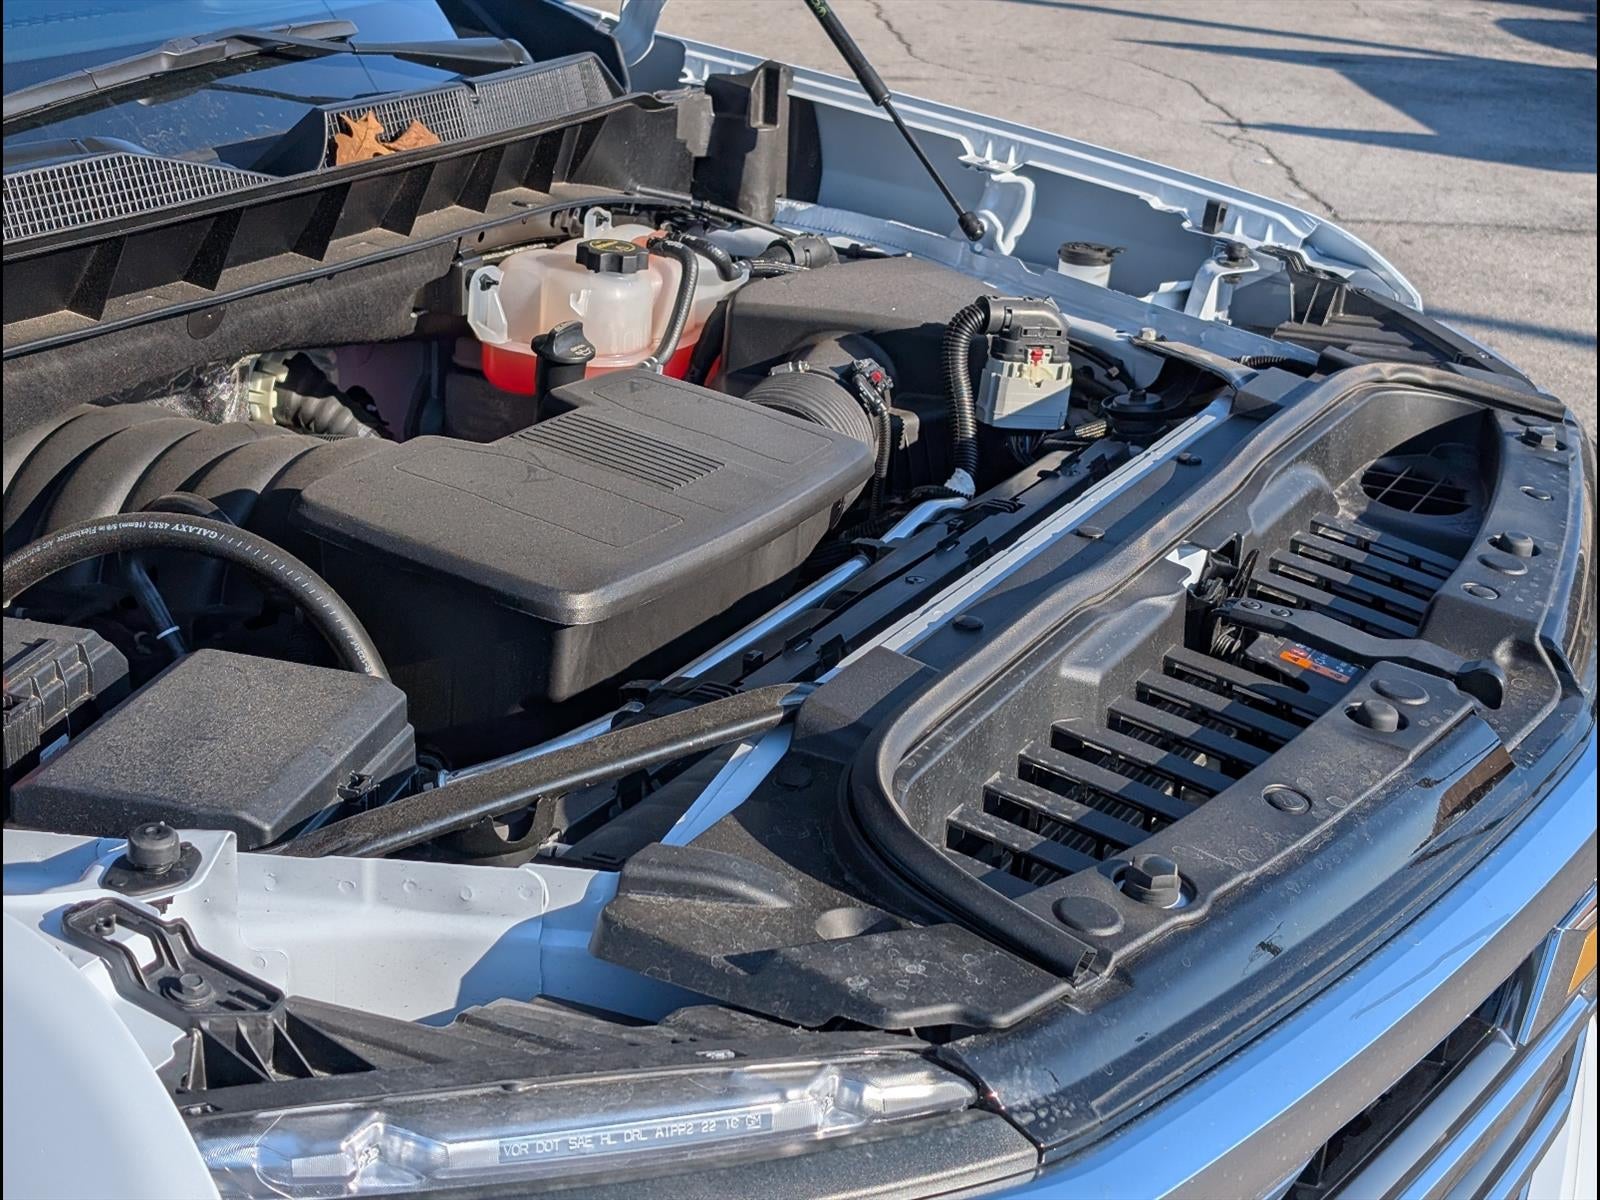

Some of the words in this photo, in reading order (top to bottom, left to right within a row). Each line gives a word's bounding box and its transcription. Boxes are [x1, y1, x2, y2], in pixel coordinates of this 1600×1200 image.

[119, 521, 146, 530] (16mm)
[148, 521, 170, 530] 4882
[171, 523, 218, 539] GALAXY
[502, 1142, 529, 1157] VOR
[536, 1138, 561, 1153] DOT
[568, 1134, 594, 1149] SAE
[600, 1132, 617, 1145] HL
[624, 1129, 648, 1142] DRL
[701, 1119, 716, 1133] 22
[746, 1112, 762, 1129] GM
